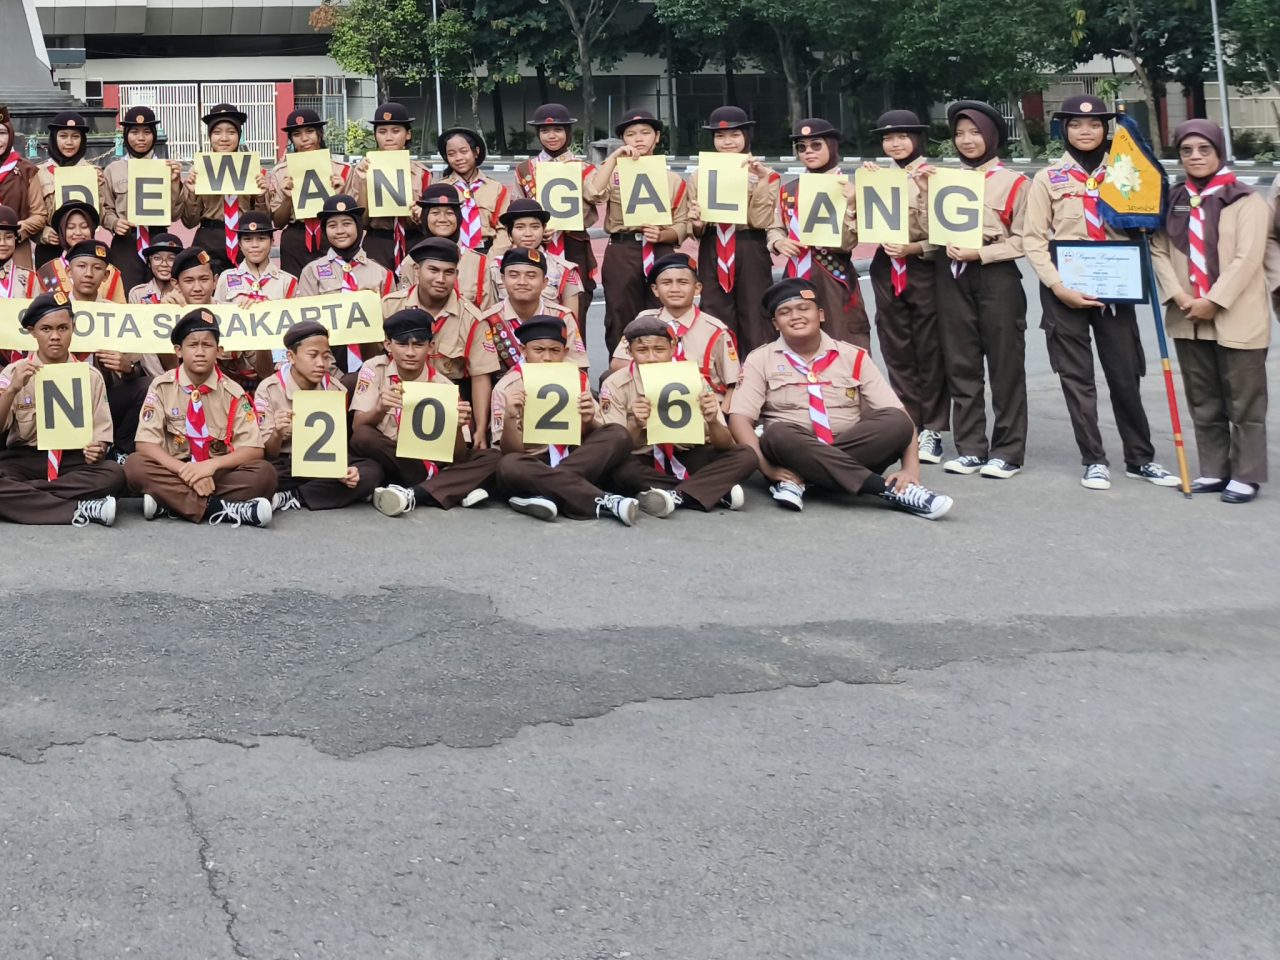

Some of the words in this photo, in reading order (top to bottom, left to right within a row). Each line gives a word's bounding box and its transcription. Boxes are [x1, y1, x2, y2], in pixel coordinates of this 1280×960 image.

[540, 170, 980, 234] GALANG
[73, 310, 142, 338] OTA
[153, 301, 371, 339] SAKARTA
[303, 381, 690, 462] 2026
